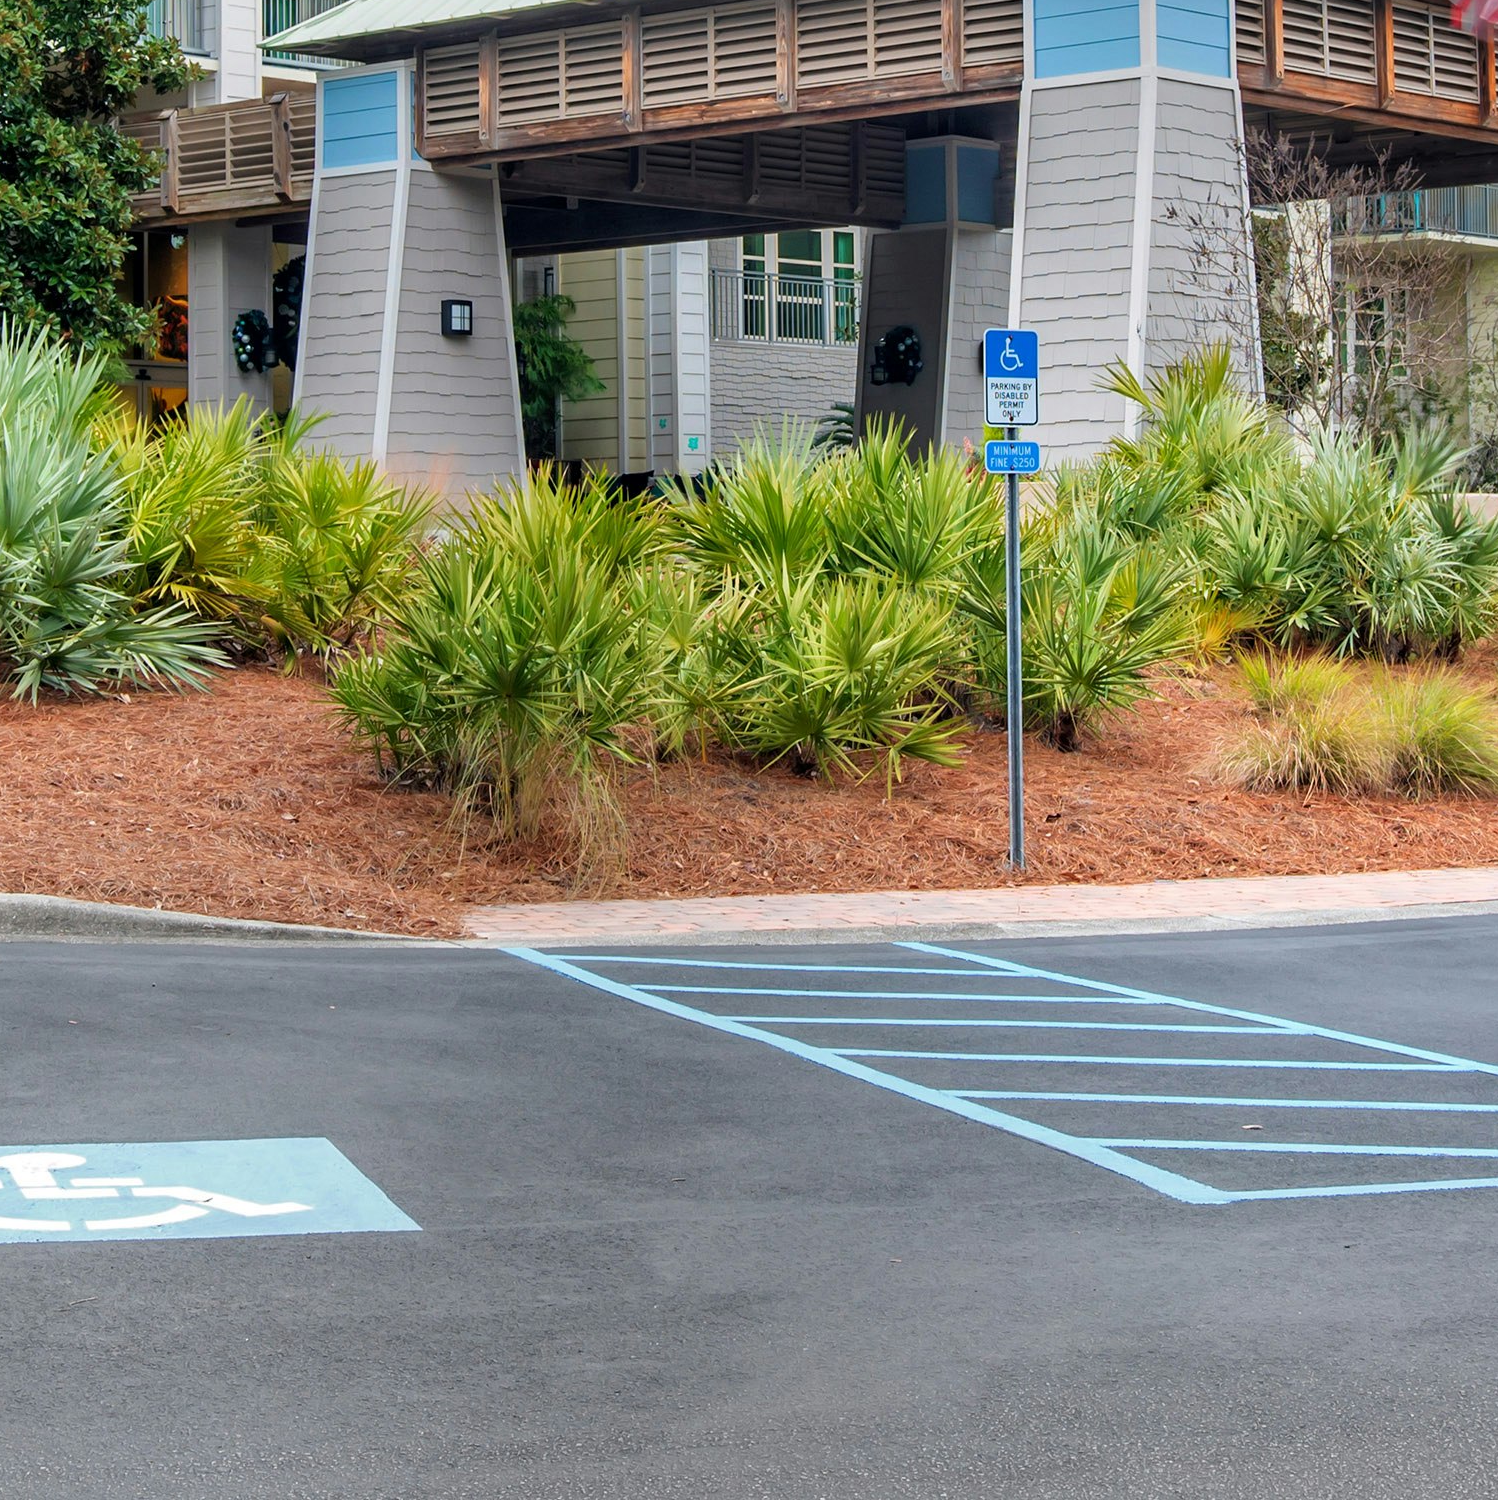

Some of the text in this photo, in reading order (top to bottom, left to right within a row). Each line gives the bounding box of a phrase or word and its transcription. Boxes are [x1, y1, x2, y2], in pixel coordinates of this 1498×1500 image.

[991, 382, 1032, 391] PARKING BY
[994, 392, 1029, 400] DISABLED
[999, 401, 1024, 409] PERMIT
[1002, 410, 1021, 418] ONLY
[993, 445, 1032, 456] MINIMUM
[990, 457, 1009, 468] FINE
